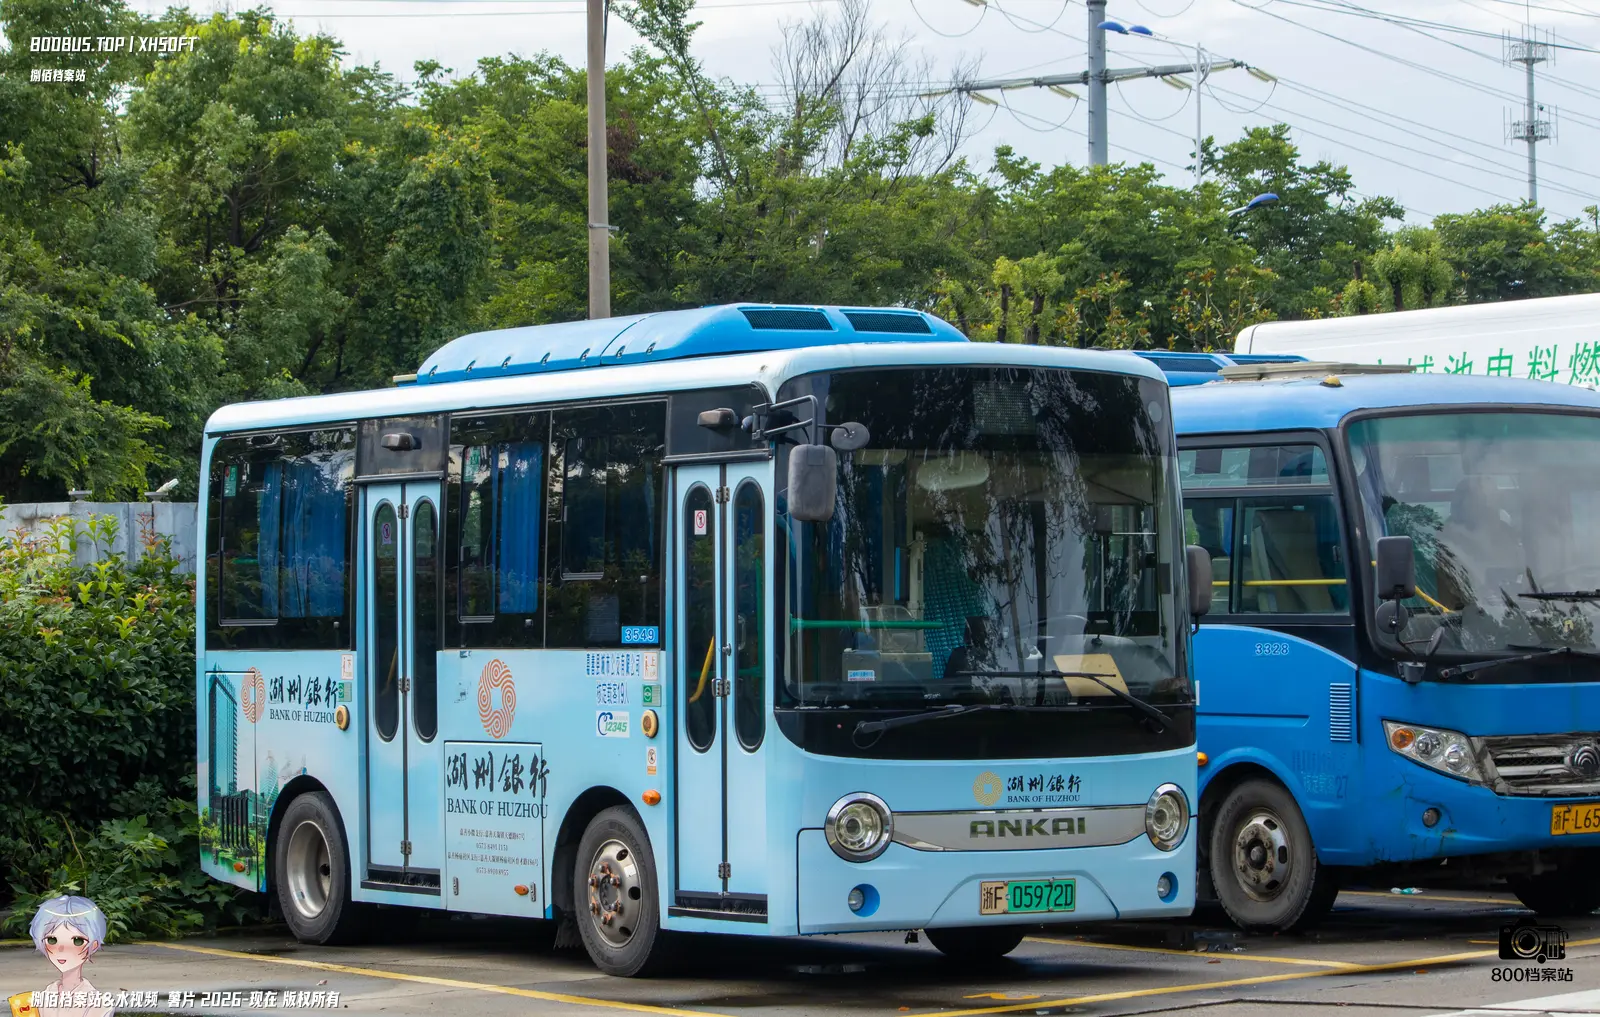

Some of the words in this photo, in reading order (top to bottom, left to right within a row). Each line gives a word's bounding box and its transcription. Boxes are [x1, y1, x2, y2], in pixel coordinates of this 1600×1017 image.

[625, 628, 655, 642] 3549
[1255, 643, 1290, 655] 3328
[269, 709, 291, 721] BANK
[292, 710, 302, 721] OF
[605, 722, 627, 732] 12345
[1007, 795, 1031, 803] BANK
[1045, 794, 1081, 802] HUZHOU
[447, 798, 477, 814] BANK
[480, 800, 494, 815] OF
[498, 801, 549, 819] HUZHOU
[969, 817, 1086, 838] ANKAI
[983, 886, 1004, 910] 浙F
[1012, 884, 1075, 909] 05972D
